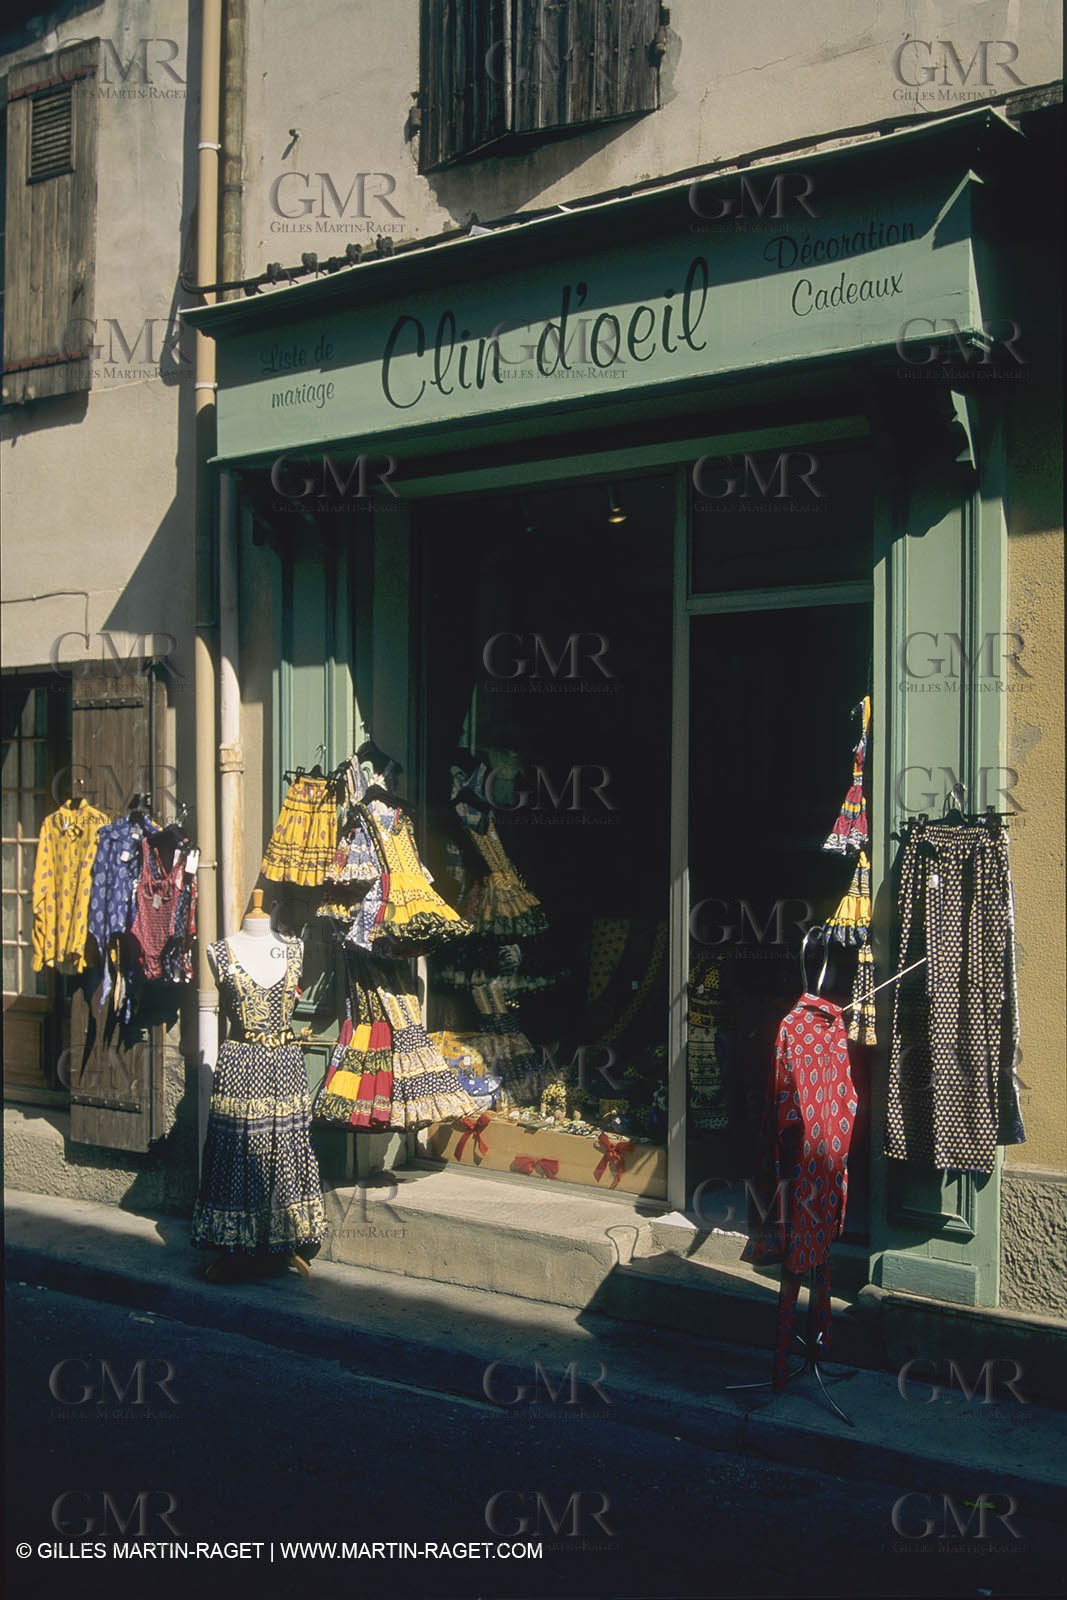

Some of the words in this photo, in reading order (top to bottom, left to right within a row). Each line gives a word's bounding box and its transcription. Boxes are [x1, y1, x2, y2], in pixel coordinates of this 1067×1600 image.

[763, 221, 915, 269] Décoration
[791, 272, 903, 317] Cadeaux
[262, 343, 306, 373] Liste
[314, 334, 335, 362] de
[382, 310, 503, 409] Clin
[537, 256, 709, 377] d'oeil
[271, 382, 335, 409] mariage
